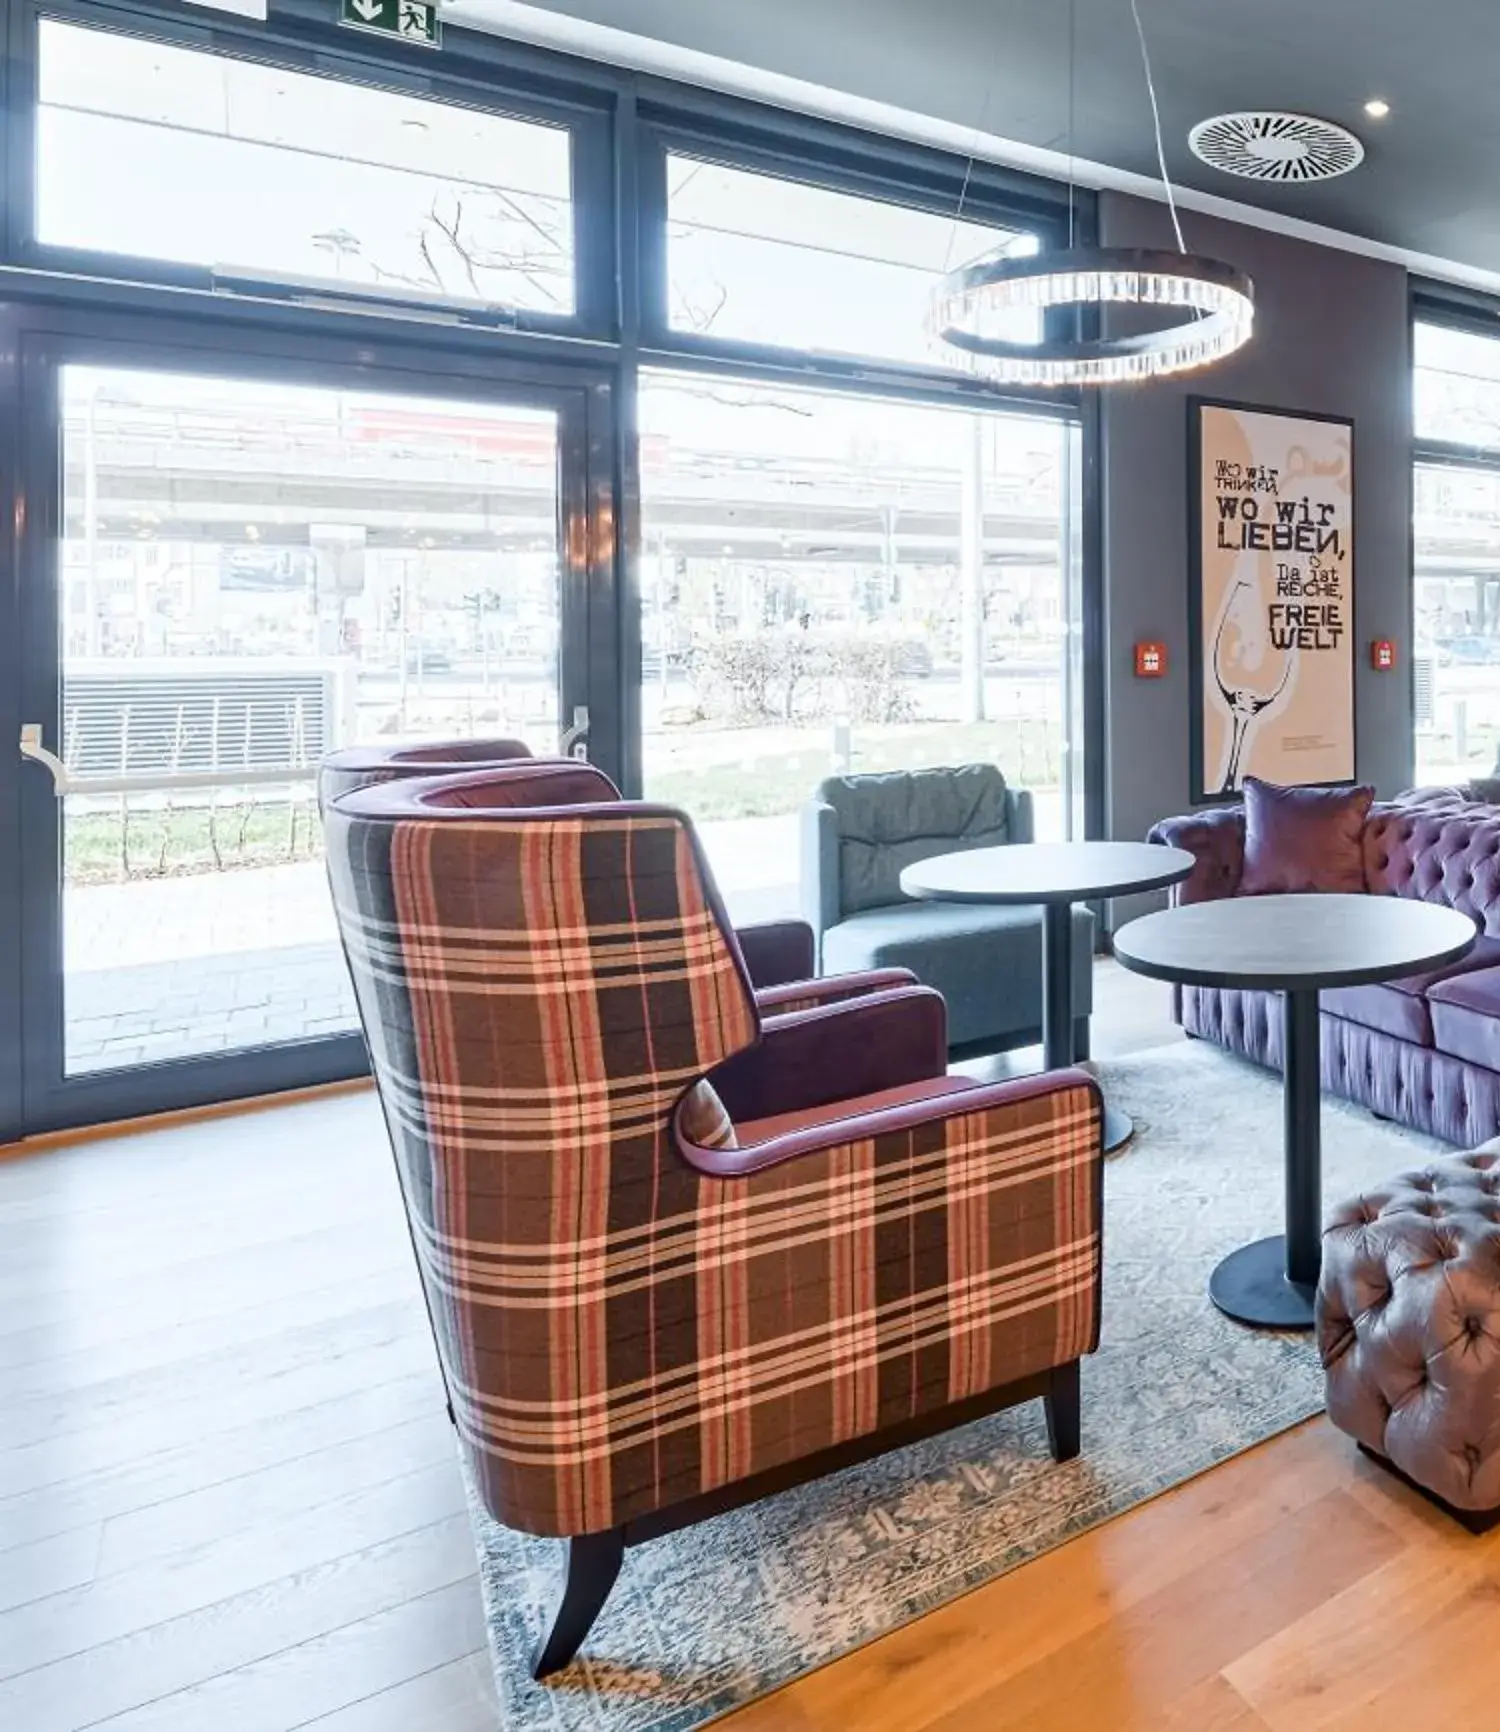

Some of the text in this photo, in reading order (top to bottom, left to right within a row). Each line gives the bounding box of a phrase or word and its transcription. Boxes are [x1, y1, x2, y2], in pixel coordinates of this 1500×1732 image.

[1217, 521, 1345, 561] LIEBEN,
[1276, 563, 1301, 581] Da
[1268, 604, 1343, 628] FREIE
[1269, 626, 1343, 650] WELT
